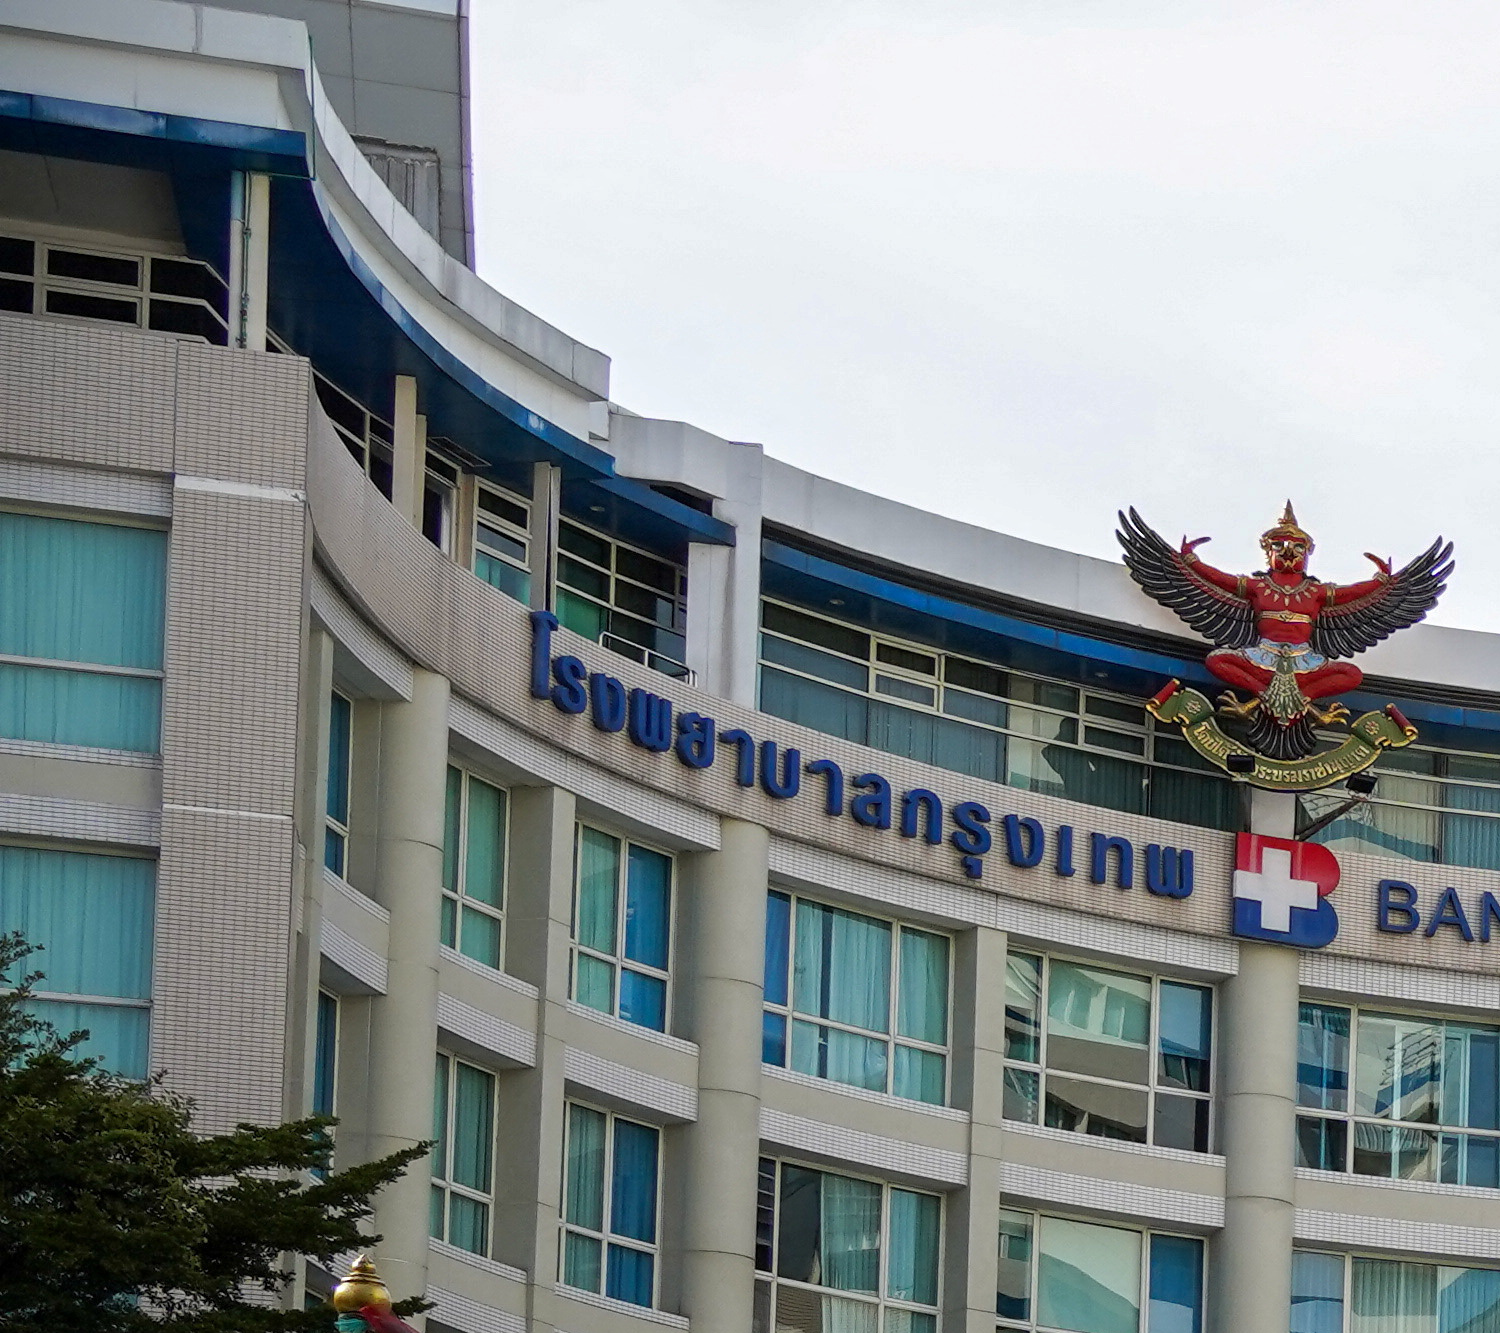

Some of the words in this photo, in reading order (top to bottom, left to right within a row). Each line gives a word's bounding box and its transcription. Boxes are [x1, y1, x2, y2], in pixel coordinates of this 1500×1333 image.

[529, 610, 1195, 899] โรงพยาบาลกรุงเทพ
